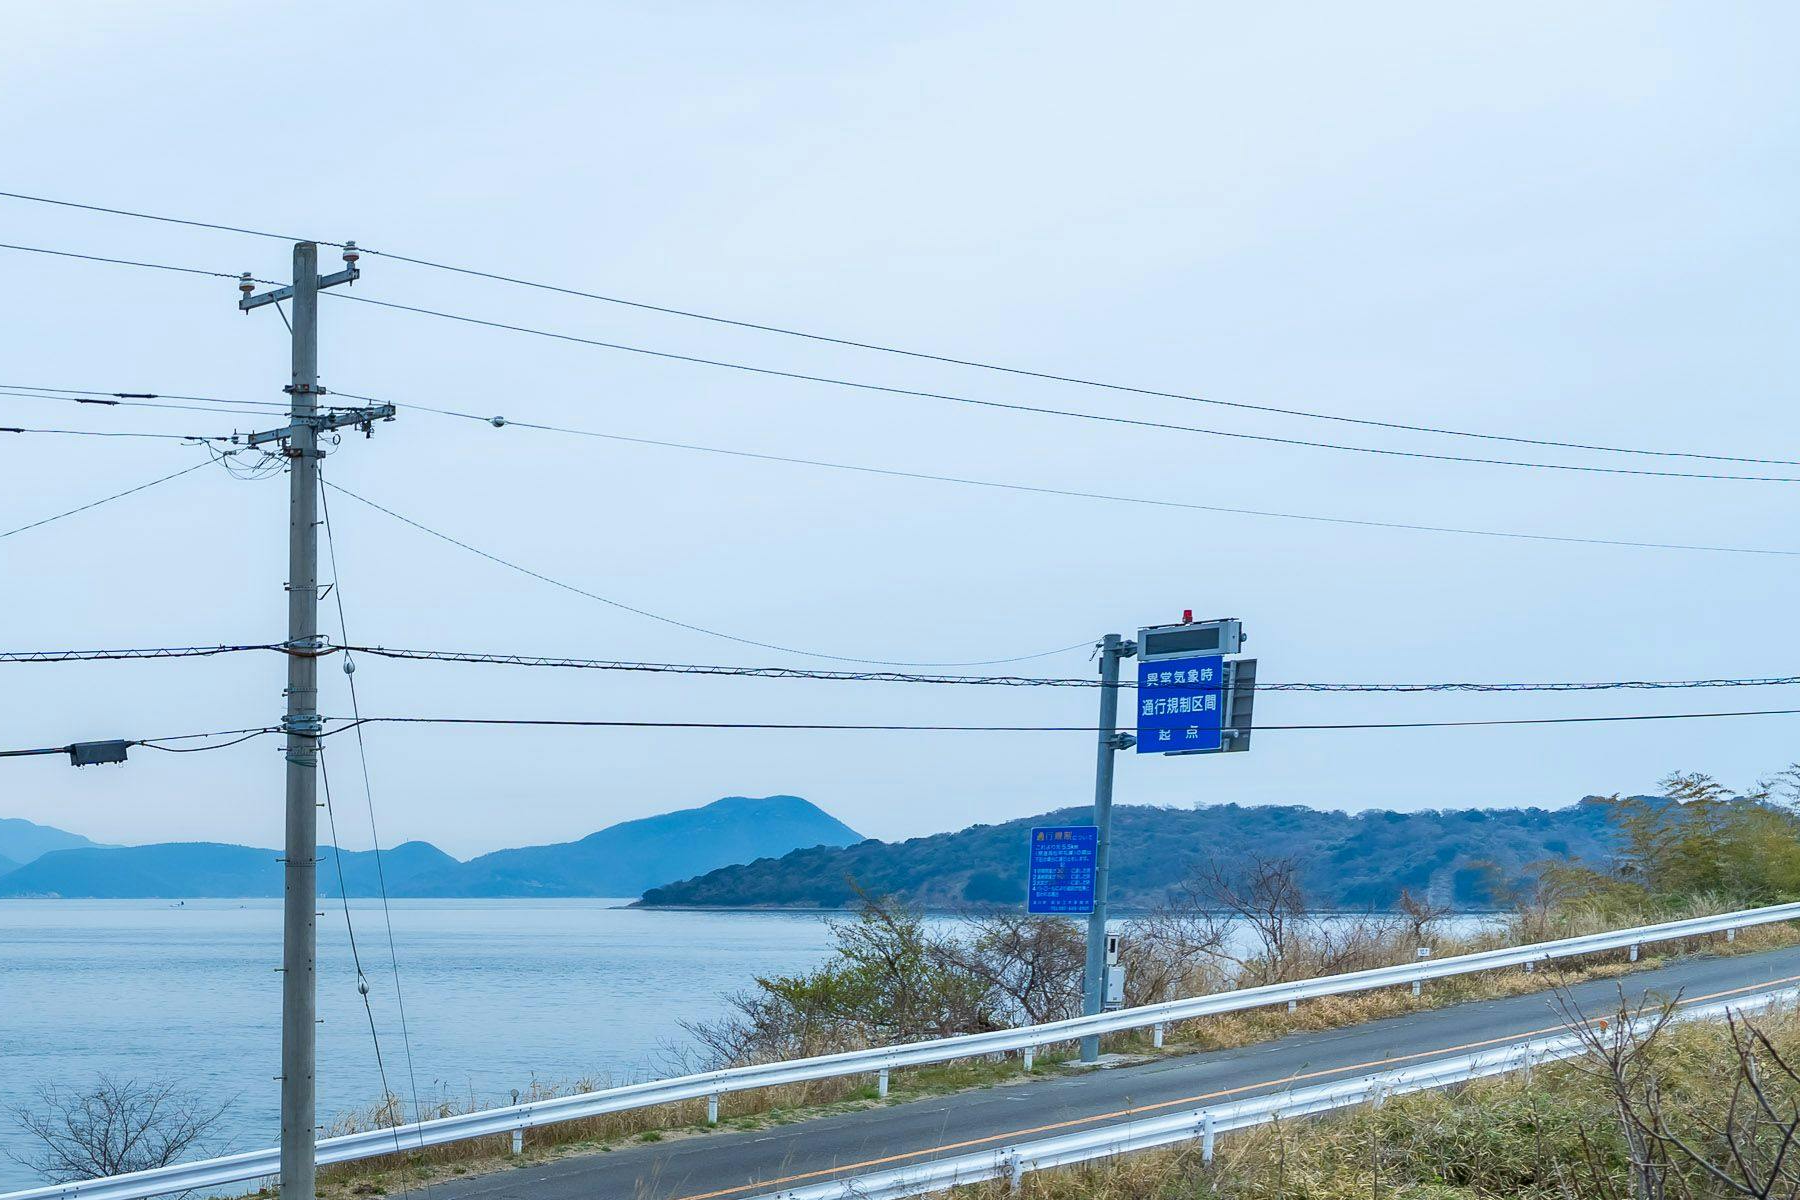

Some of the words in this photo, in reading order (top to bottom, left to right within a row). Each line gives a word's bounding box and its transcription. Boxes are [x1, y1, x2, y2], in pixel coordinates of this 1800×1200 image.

[1146, 667, 1214, 687] 異常気象時
[1142, 694, 1217, 717] 通行規制区間
